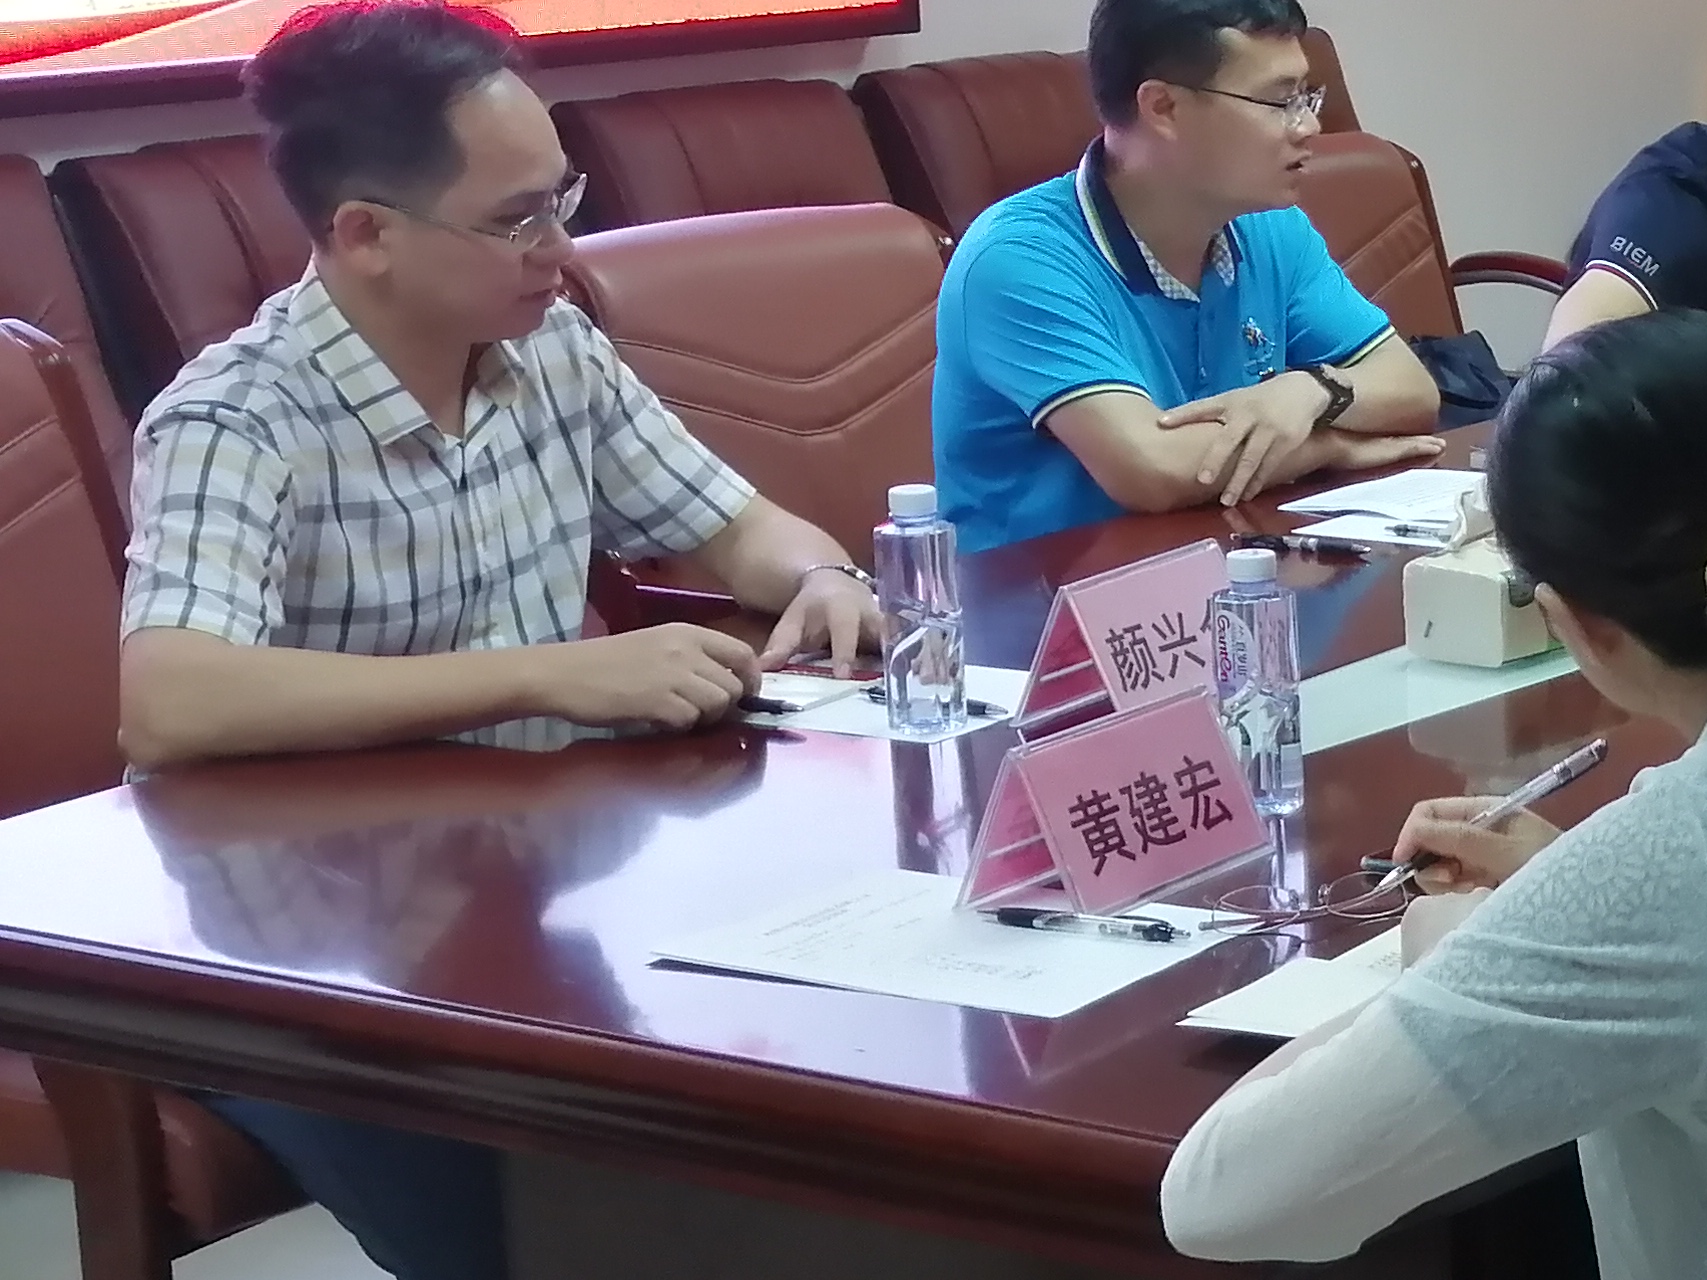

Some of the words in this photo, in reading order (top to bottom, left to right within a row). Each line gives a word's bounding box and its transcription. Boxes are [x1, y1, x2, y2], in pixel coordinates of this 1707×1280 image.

[1610, 236, 1660, 277] BIEM
[1105, 598, 1212, 692] 颜兴
[1068, 755, 1233, 877] 黄建宏
